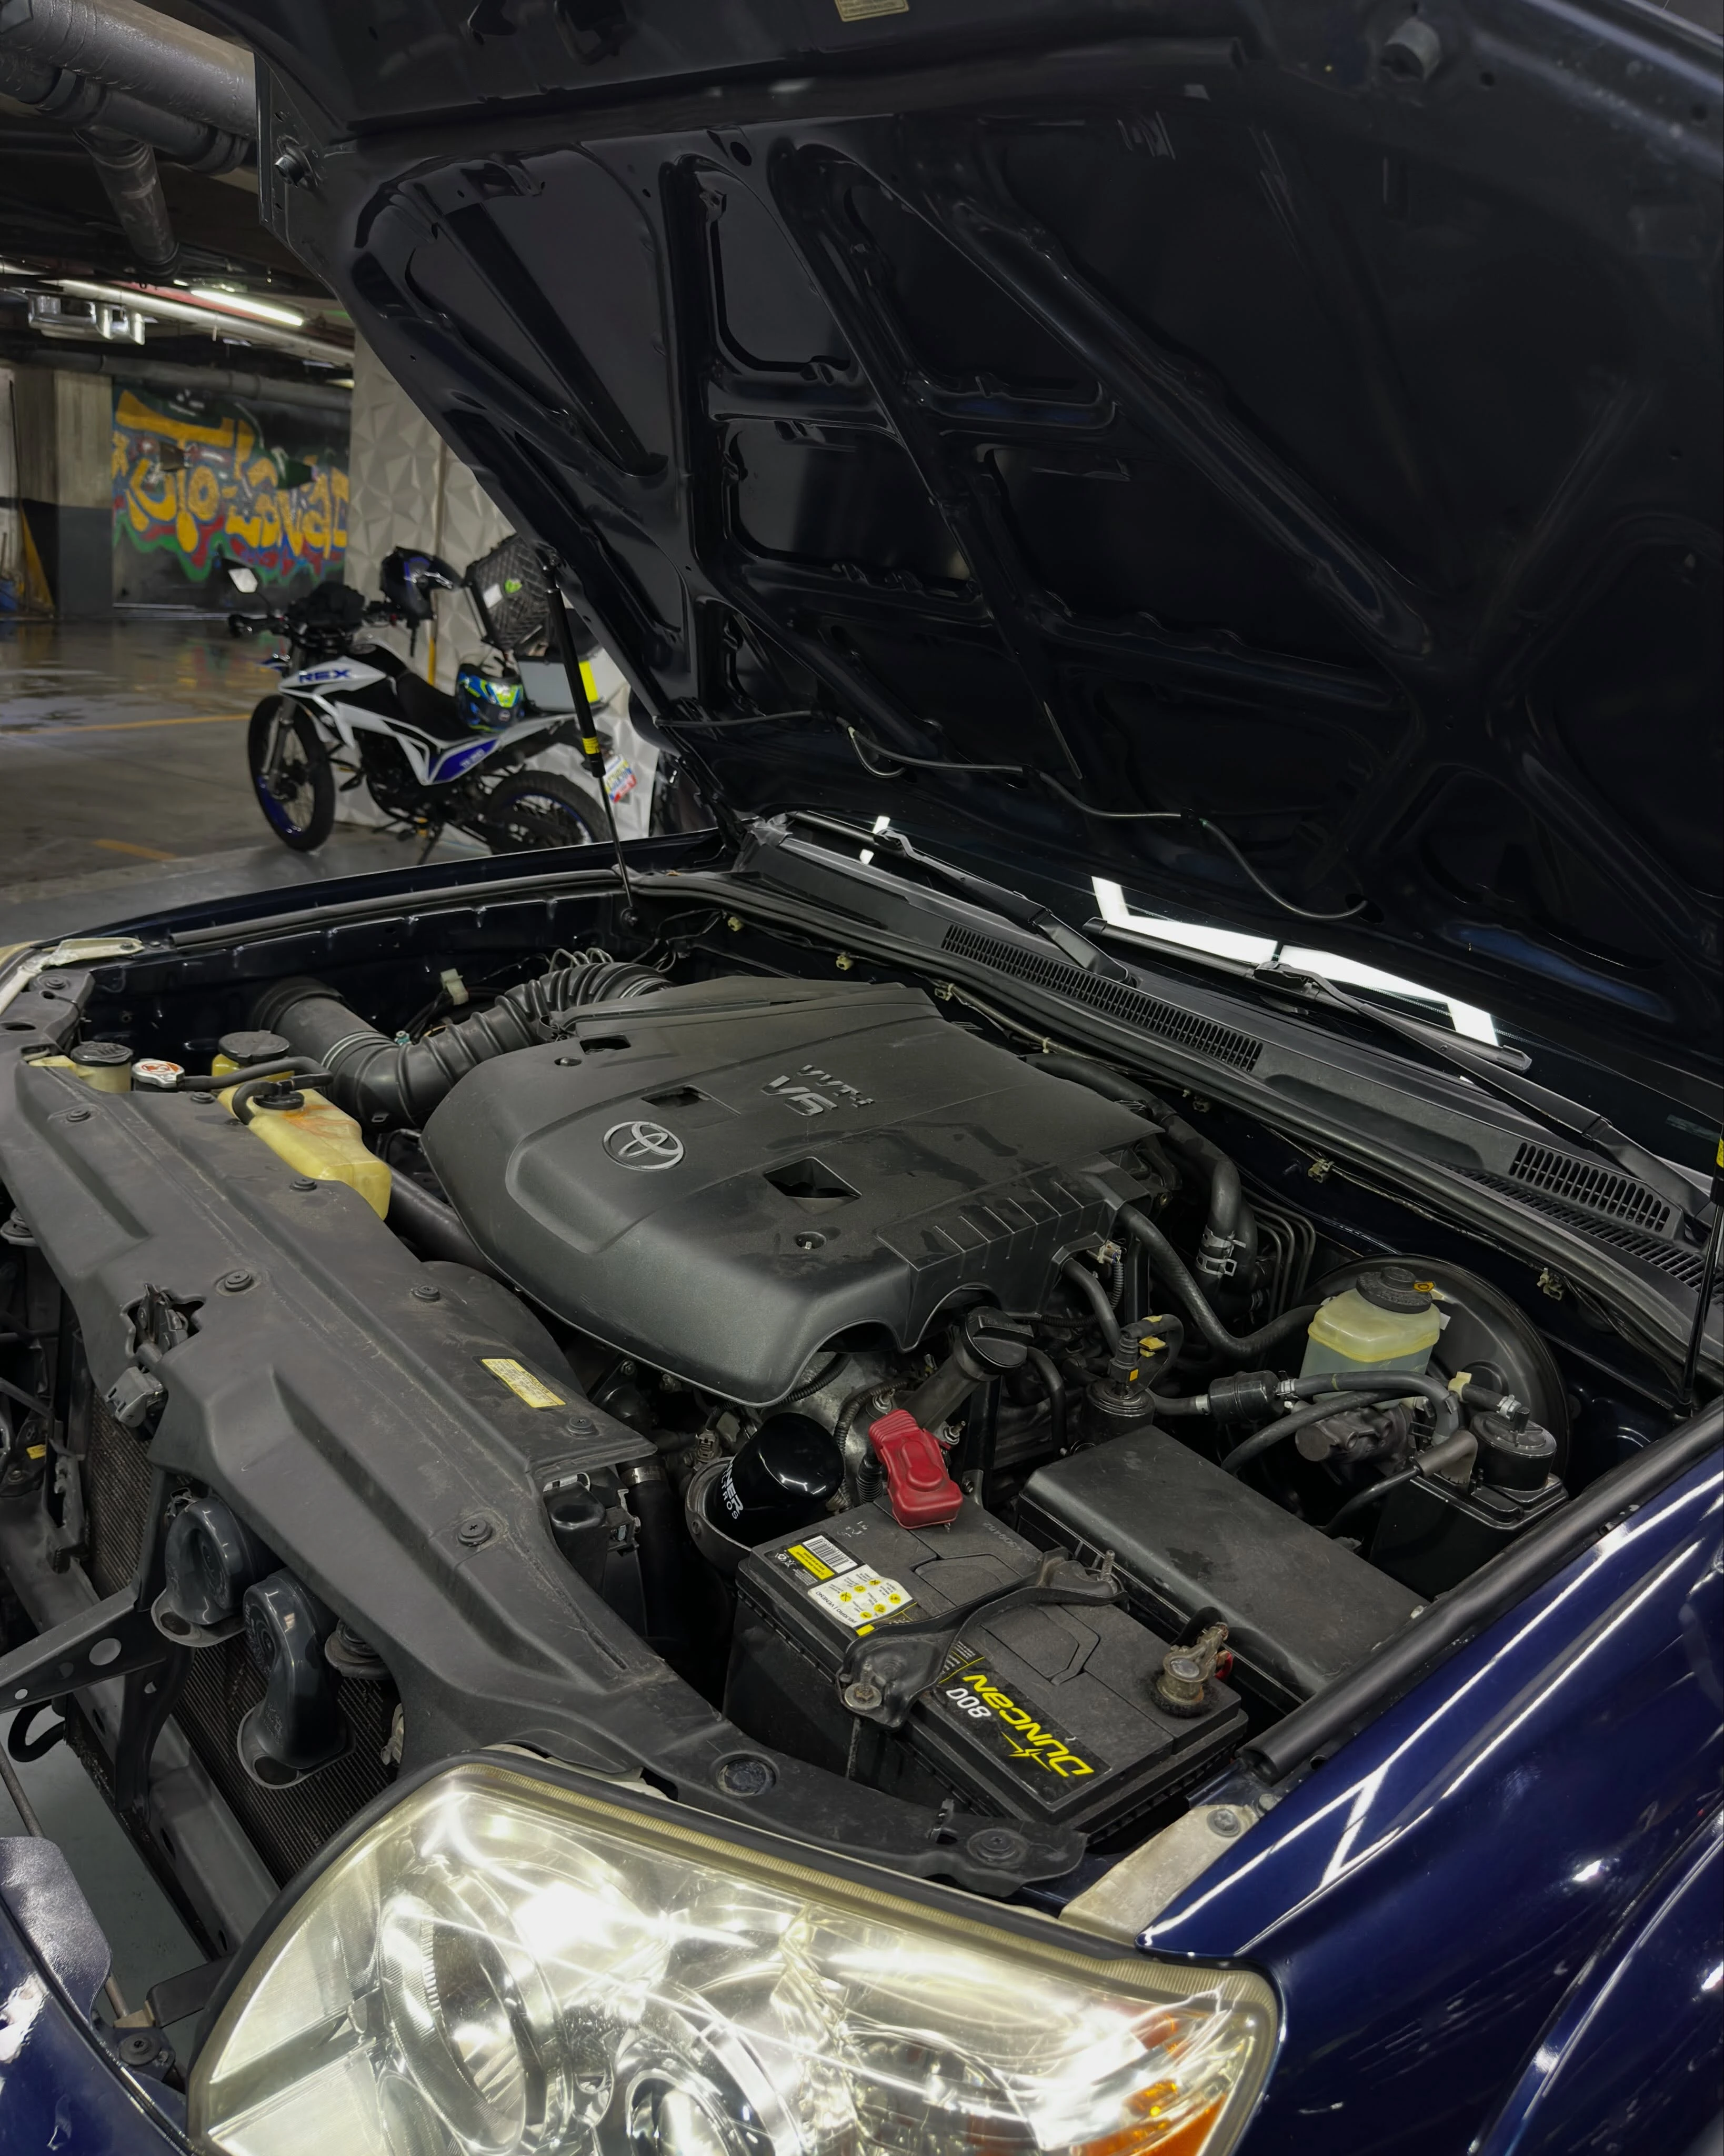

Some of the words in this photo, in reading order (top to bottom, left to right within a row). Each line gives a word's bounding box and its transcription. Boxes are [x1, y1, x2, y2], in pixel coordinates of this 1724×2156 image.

[299, 668, 350, 683] REX
[761, 1075, 838, 1116] V6
[816, 1591, 835, 1608] VENENO
[836, 1609, 857, 1623] PELIGRO
[946, 1688, 991, 1718] 800
